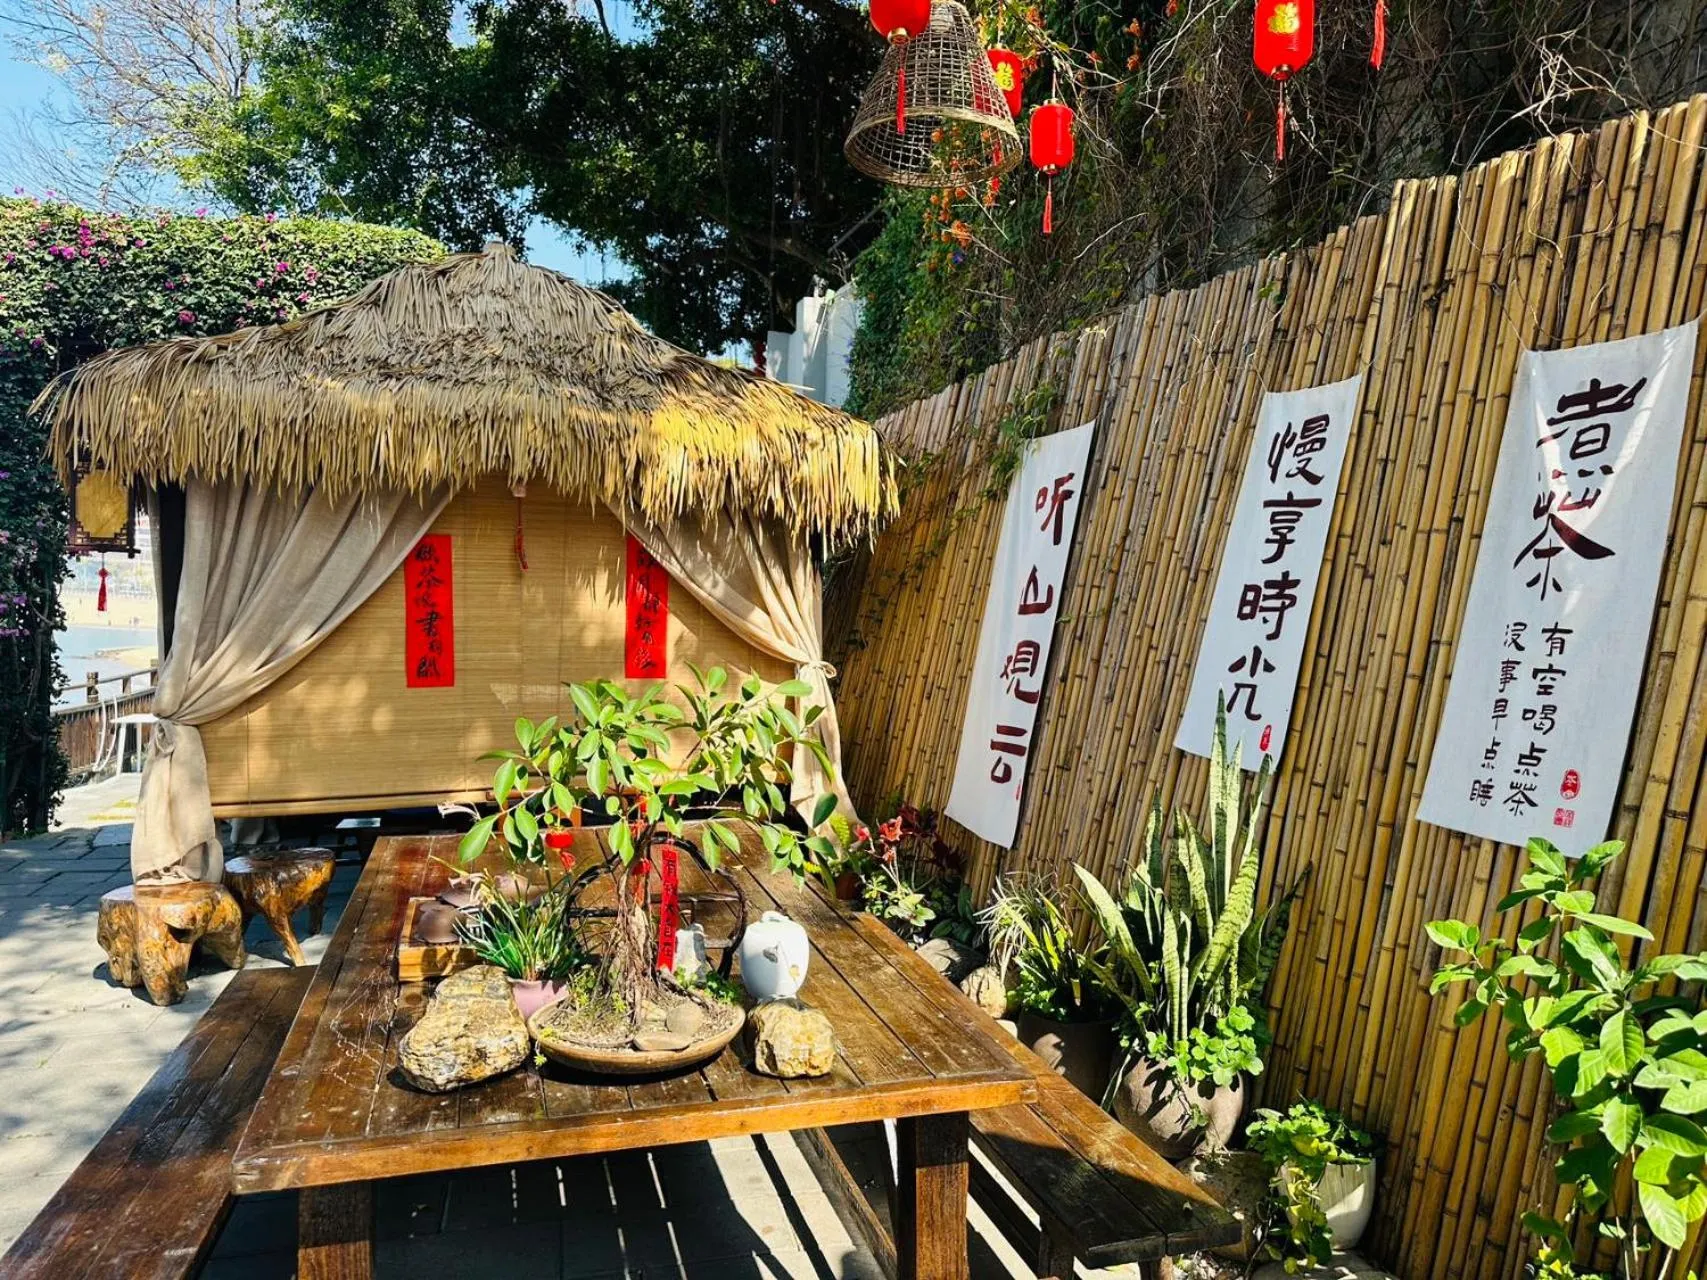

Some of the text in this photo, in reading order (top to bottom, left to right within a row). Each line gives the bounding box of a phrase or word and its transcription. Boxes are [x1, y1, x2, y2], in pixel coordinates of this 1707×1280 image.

[1267, 2, 1300, 34] 福
[1513, 377, 1648, 601] 煮茶
[1502, 621, 1574, 817] 有空喝点茶
